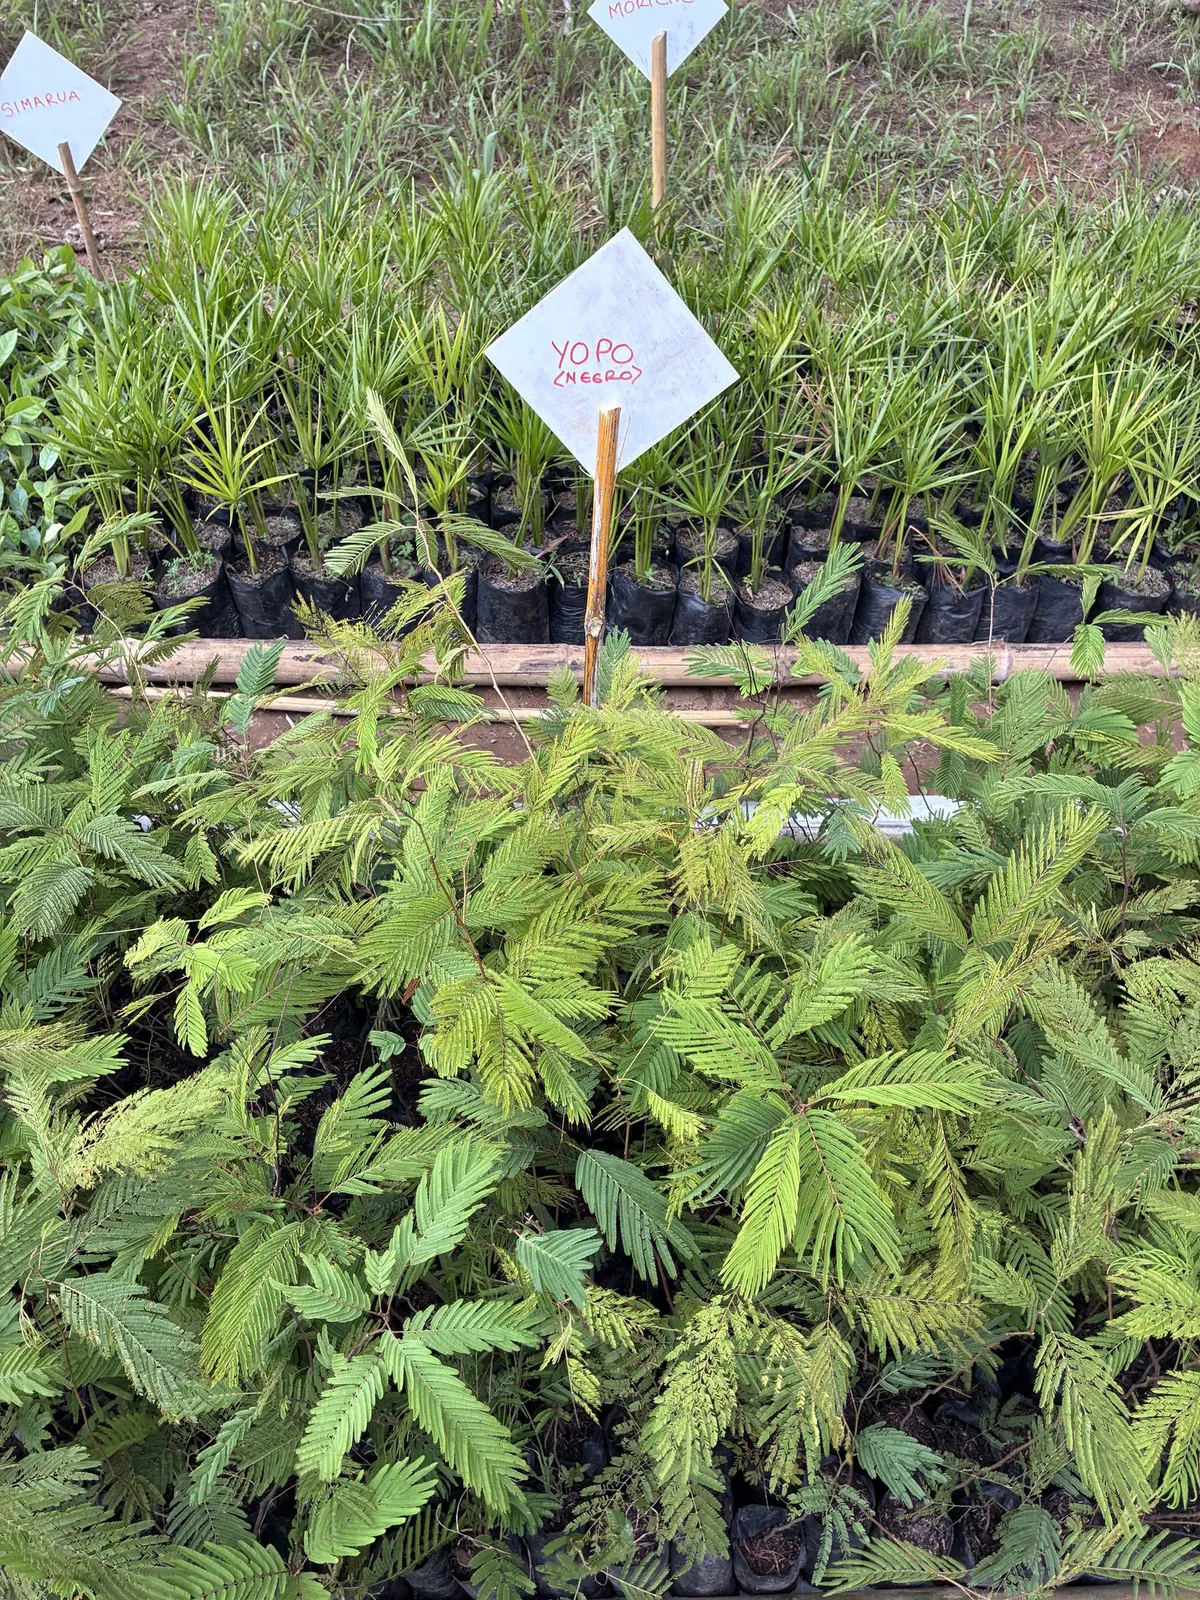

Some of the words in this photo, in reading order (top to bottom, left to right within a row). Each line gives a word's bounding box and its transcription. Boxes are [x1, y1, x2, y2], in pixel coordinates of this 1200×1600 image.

[608, 0, 694, 19] MORI
[1, 90, 81, 118] SIMARUA
[551, 338, 634, 369] YOPO
